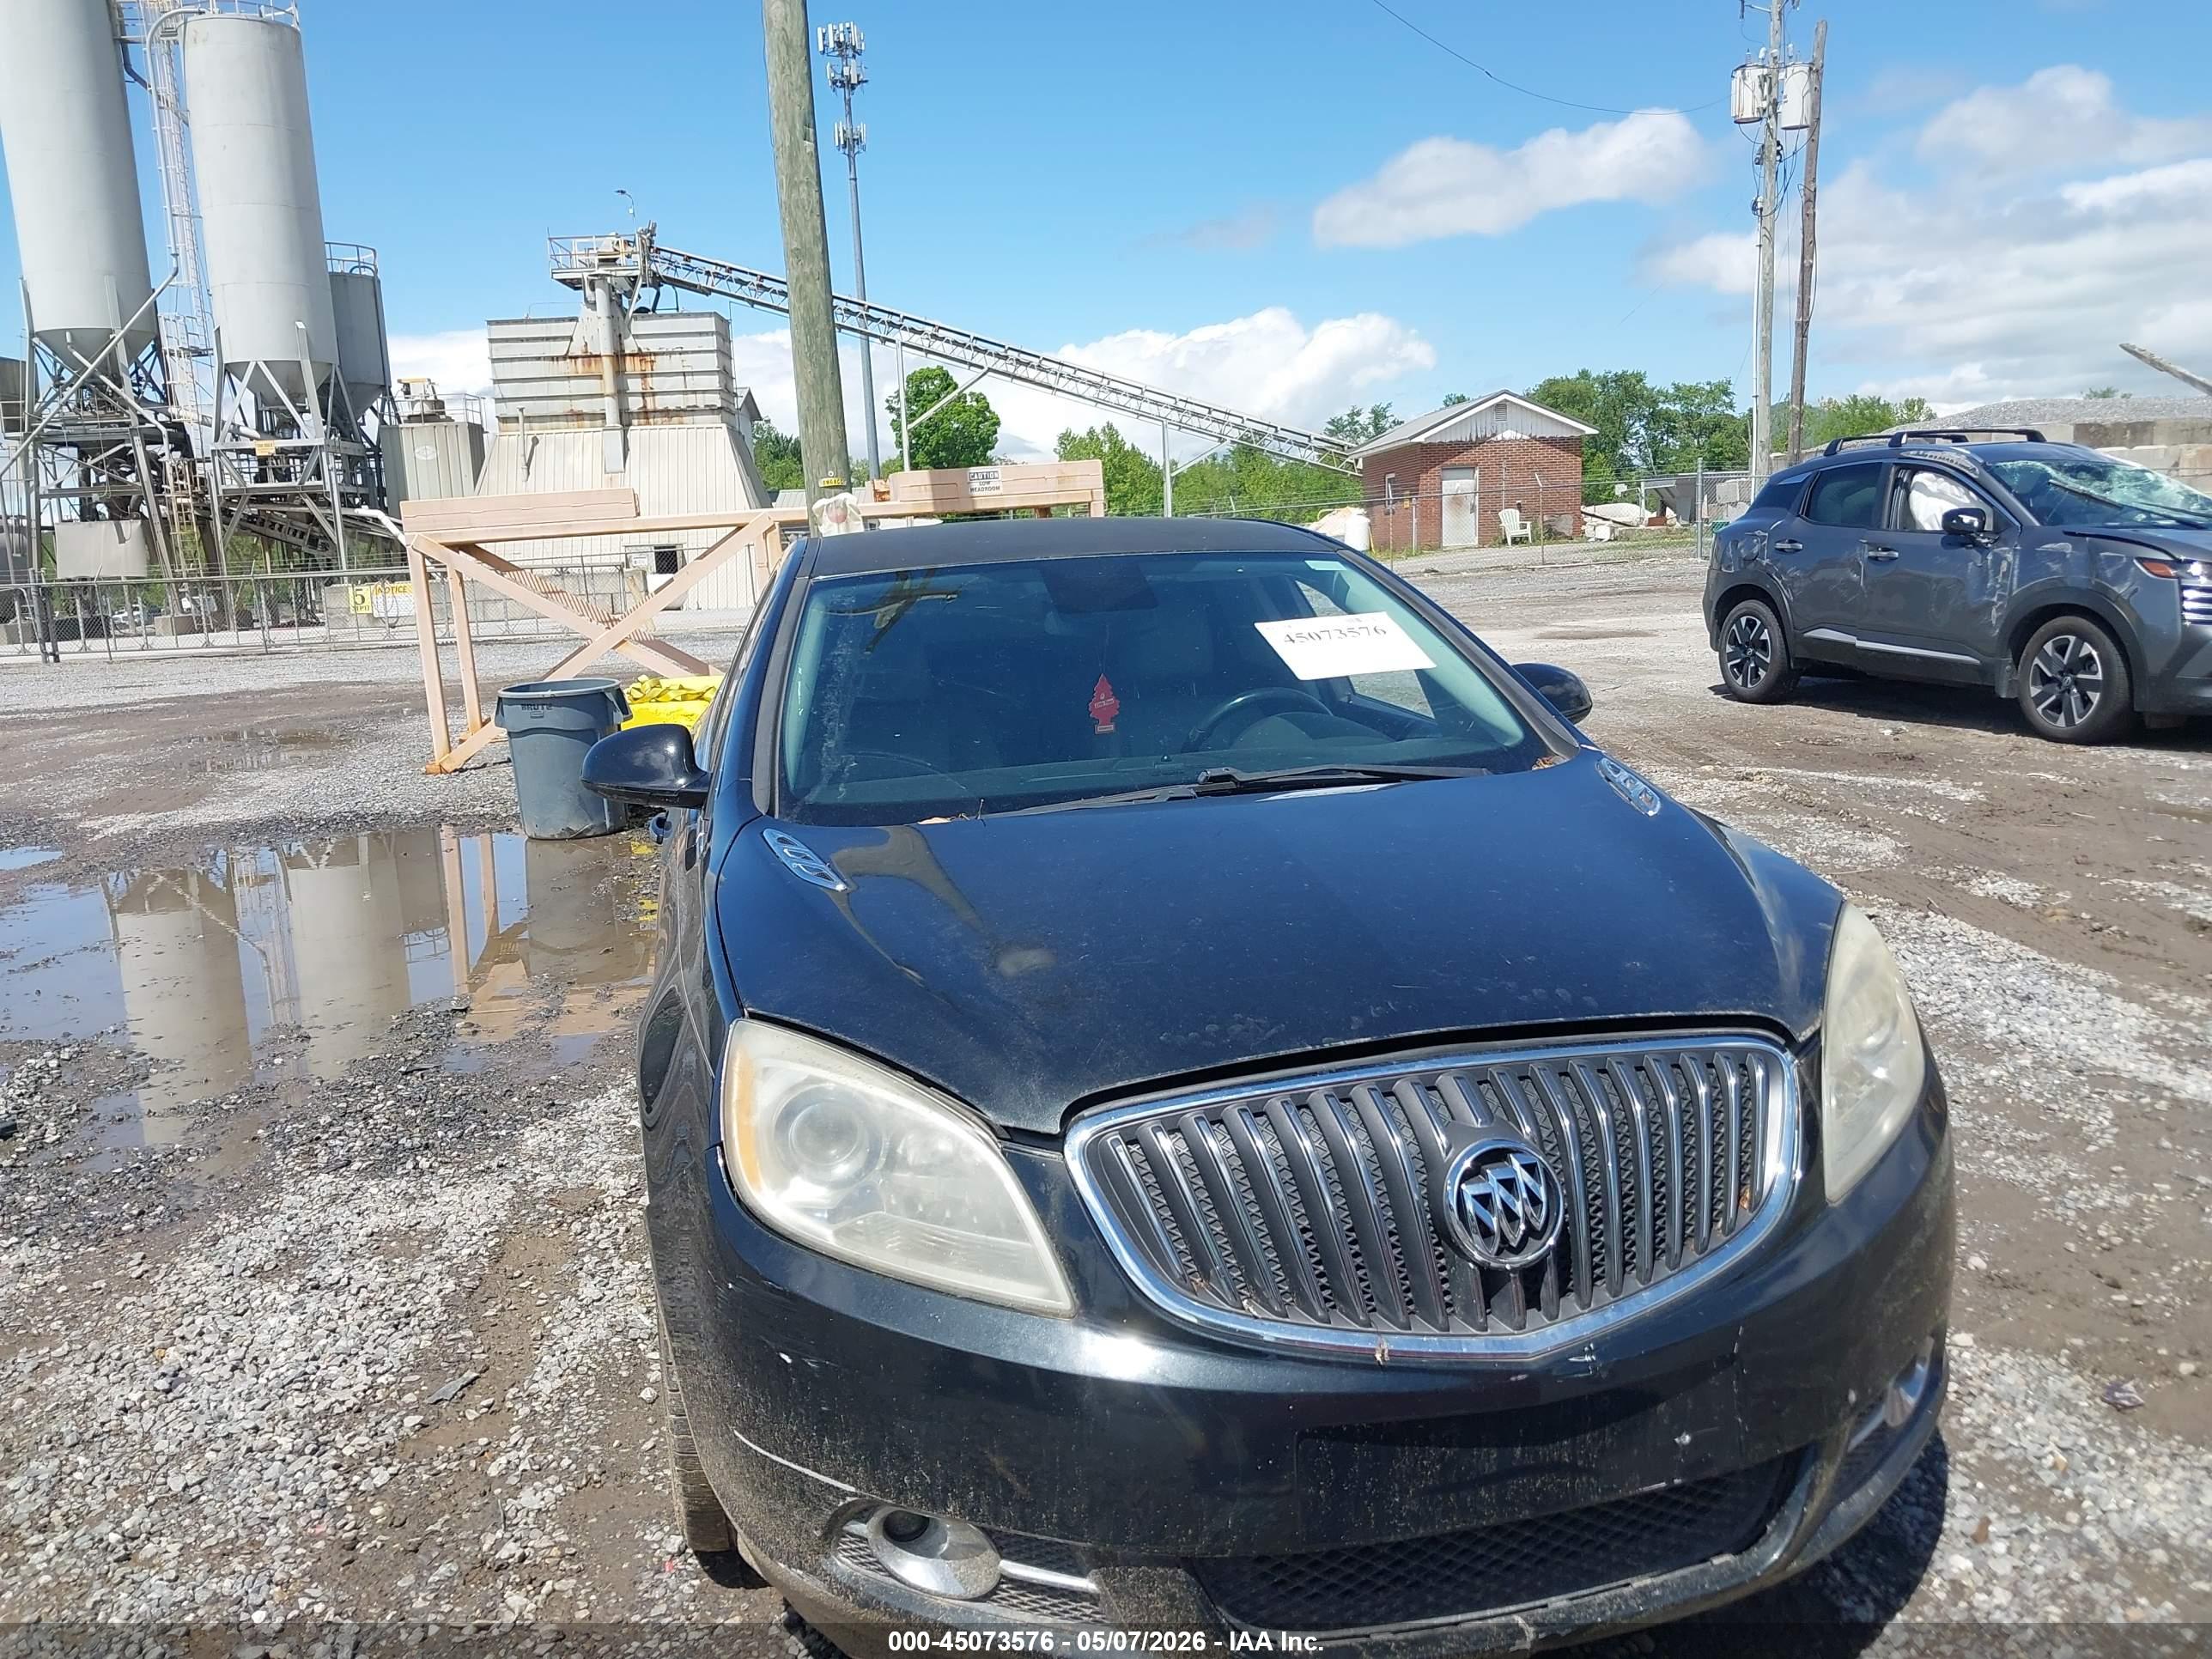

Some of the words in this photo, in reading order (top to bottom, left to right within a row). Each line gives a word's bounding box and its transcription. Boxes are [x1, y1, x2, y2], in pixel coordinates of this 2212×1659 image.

[969, 471, 1000, 480] CAUTION
[378, 586, 407, 594] NOTICE
[1284, 625, 1387, 644] 45073576
